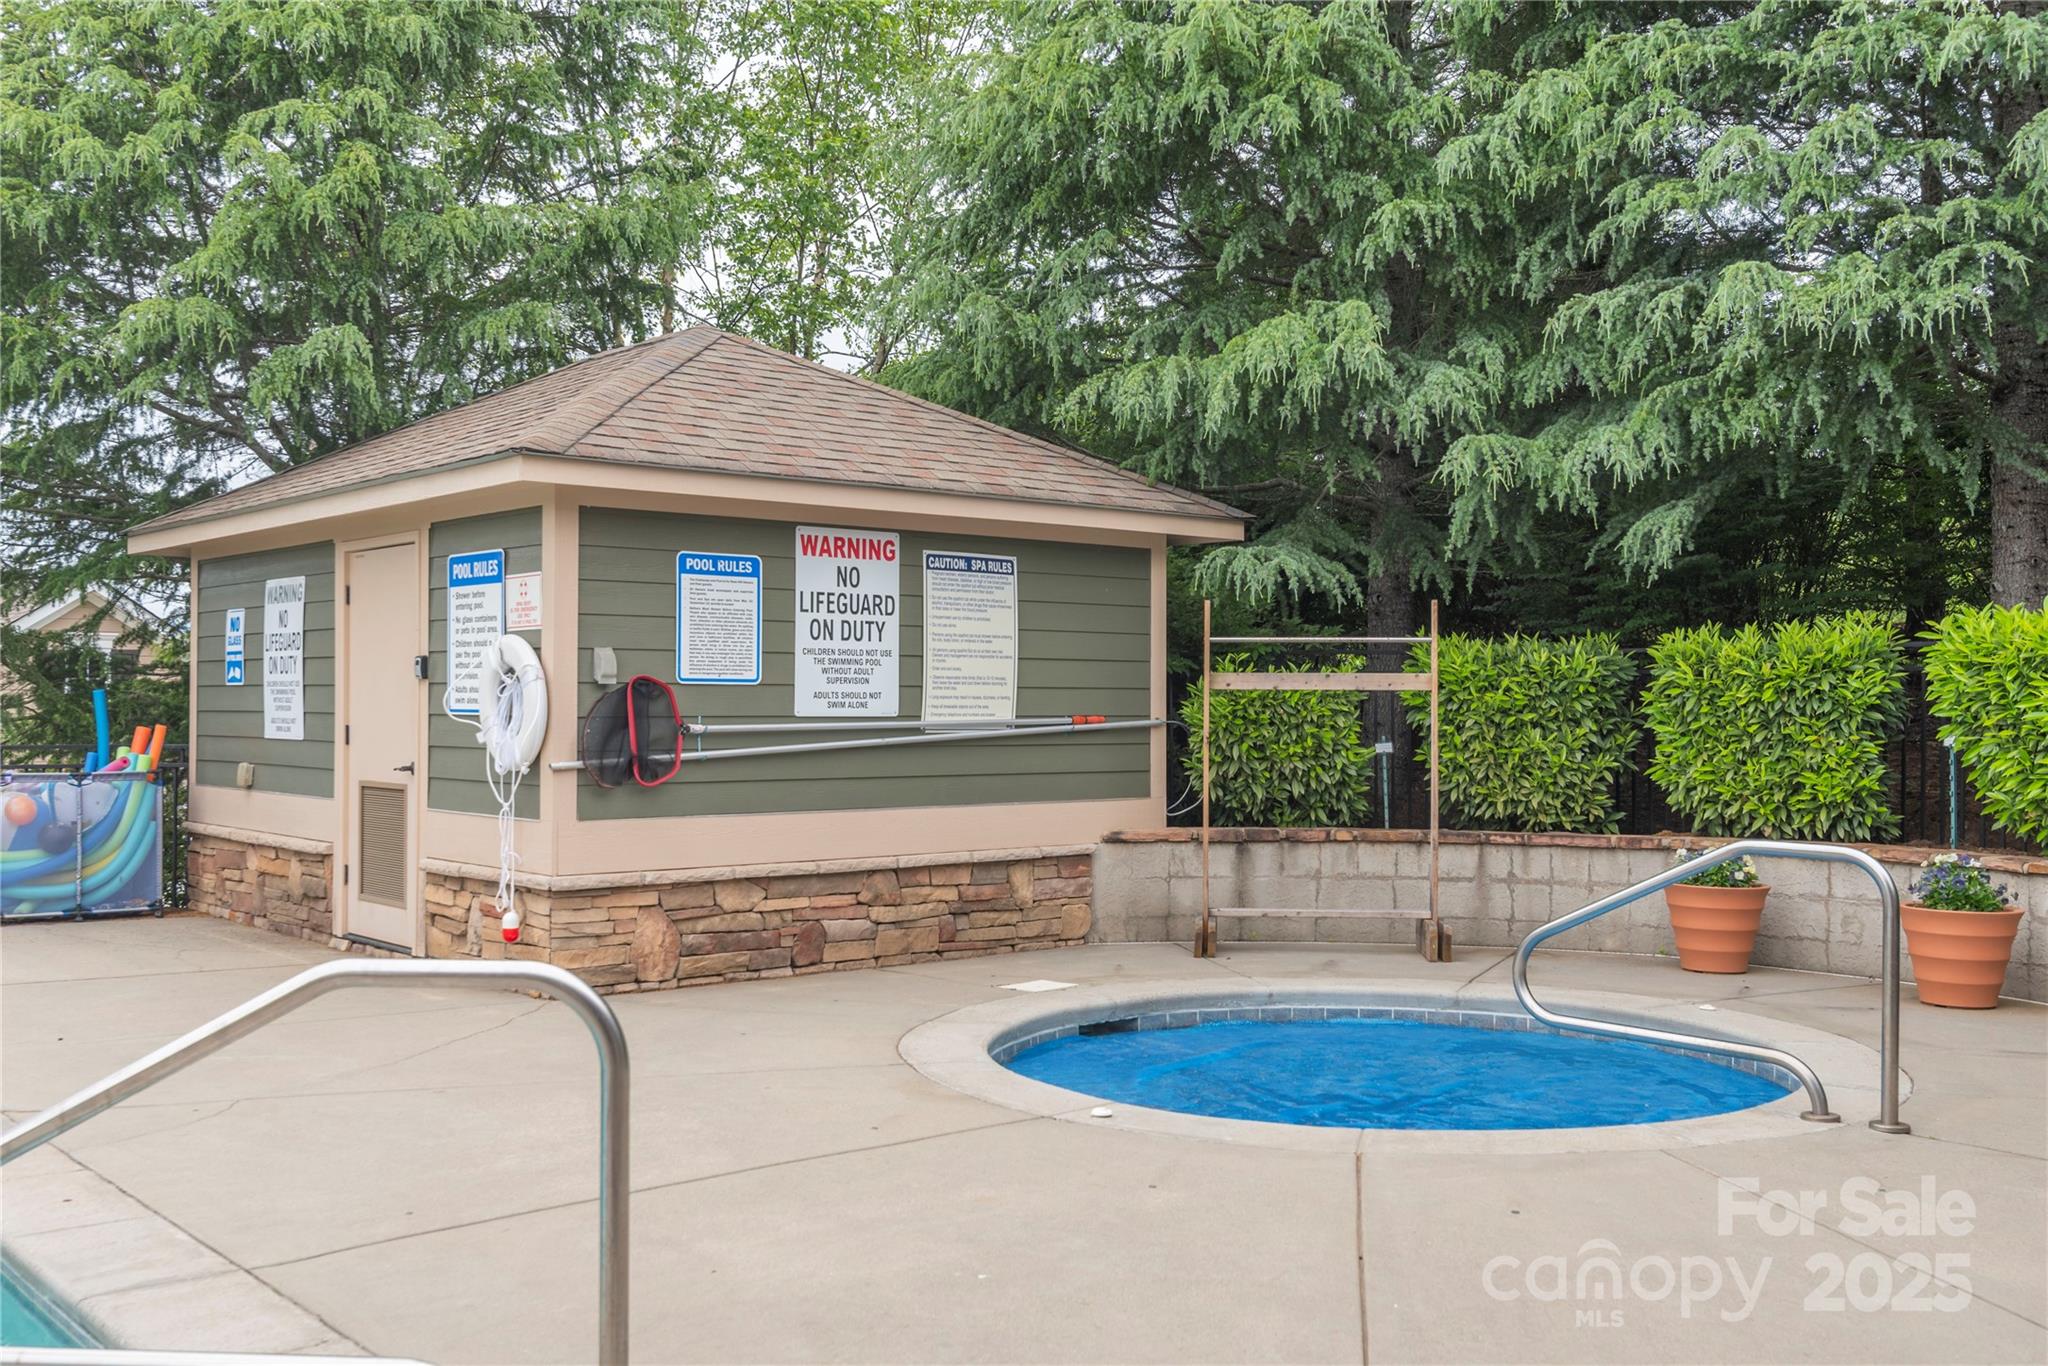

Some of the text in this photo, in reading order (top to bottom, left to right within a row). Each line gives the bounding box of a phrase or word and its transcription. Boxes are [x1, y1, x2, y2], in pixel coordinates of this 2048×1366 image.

[800, 534, 896, 562] WARNING
[453, 560, 499, 580] POOL RULES
[685, 558, 753, 573] POOL RULES
[928, 557, 1013, 574] CAUTION: SPA RULES
[837, 565, 860, 588] NO
[267, 583, 303, 605] WARNING
[800, 591, 895, 616] LIFEGUARD
[230, 616, 240, 632] NO
[279, 609, 288, 628] NO
[810, 618, 886, 642] ON DUTY
[266, 632, 301, 652] LIFEGUARD
[455, 639, 472, 648] Children
[802, 647, 892, 657] CHILDREN SHOULD NOT USE
[269, 655, 297, 674] ON DUTY
[814, 657, 882, 666] THE SWIMMING POOL
[821, 667, 874, 675] WITHOUT ADULT
[826, 676, 869, 685] SUPERVISION
[813, 691, 839, 699] ADULTS
[841, 691, 867, 699] SHOULD
[827, 701, 869, 709] SWIM ALONE
